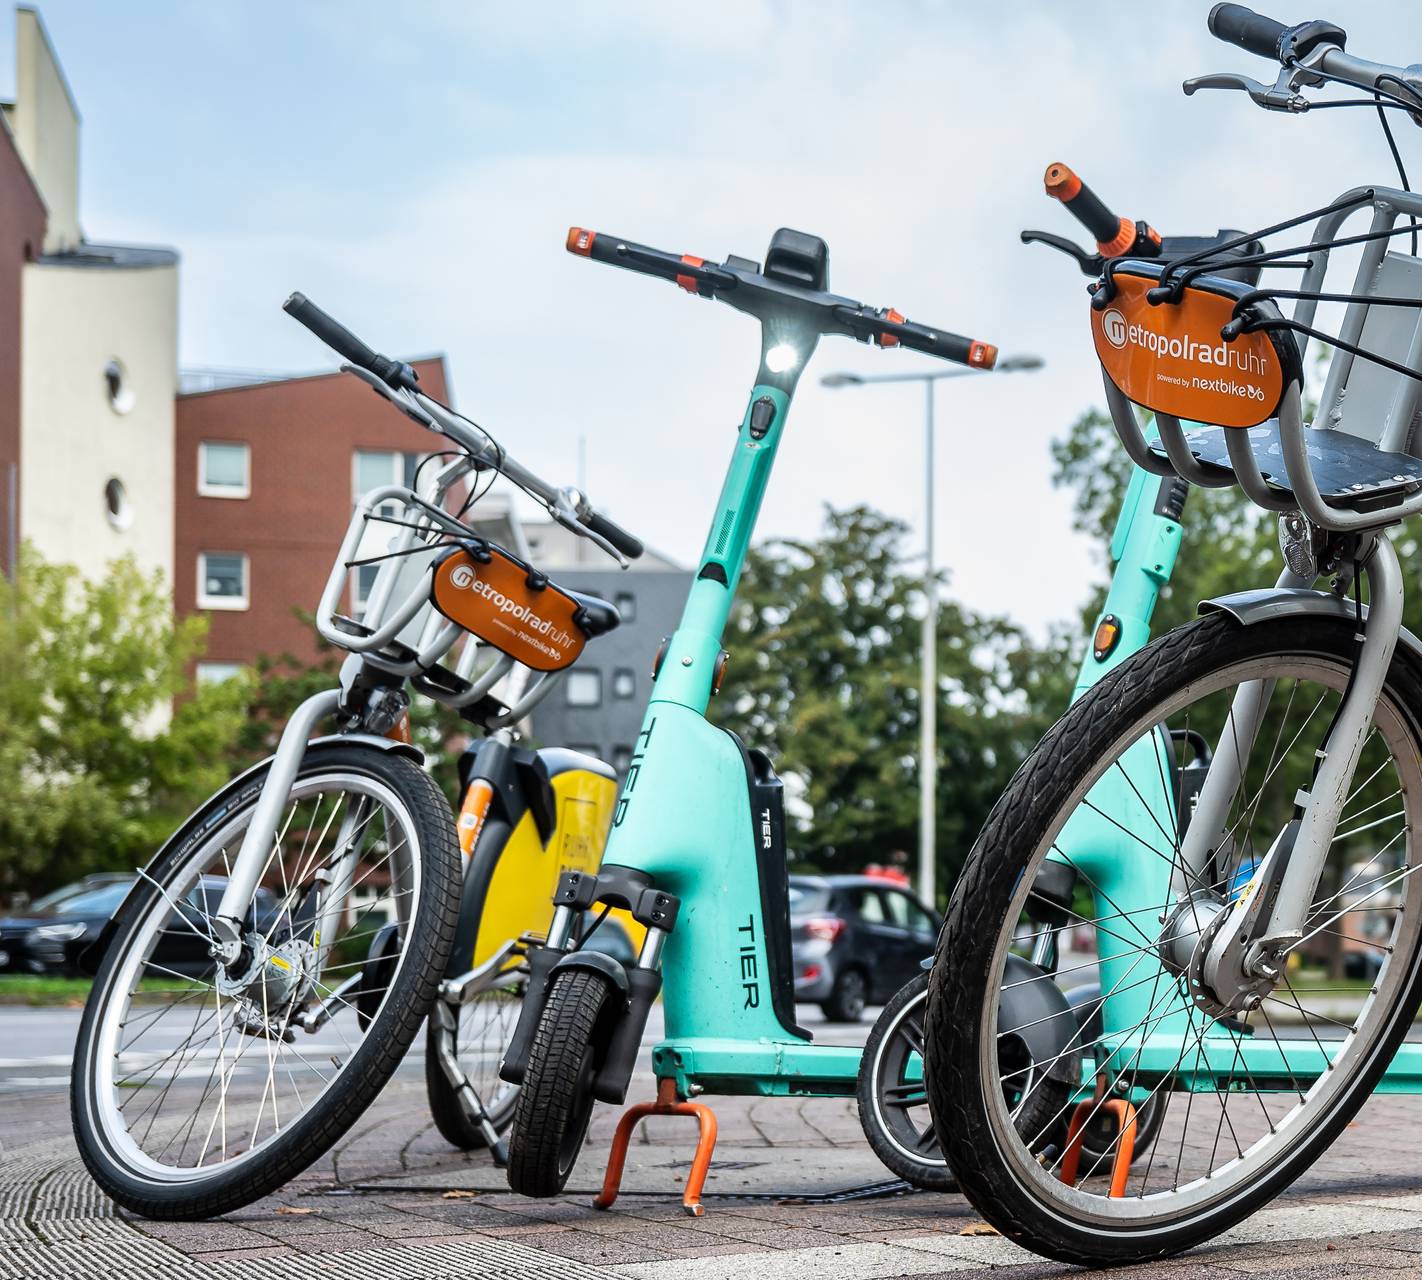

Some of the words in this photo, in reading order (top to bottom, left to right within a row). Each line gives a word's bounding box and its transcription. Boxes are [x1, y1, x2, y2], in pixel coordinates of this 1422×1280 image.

[1156, 373, 1181, 385] powered
[1181, 378, 1190, 387] by
[1192, 376, 1246, 397] nextbike
[518, 631, 550, 656] nextbike
[760, 808, 772, 849] TIER
[738, 913, 760, 1010] TIER
